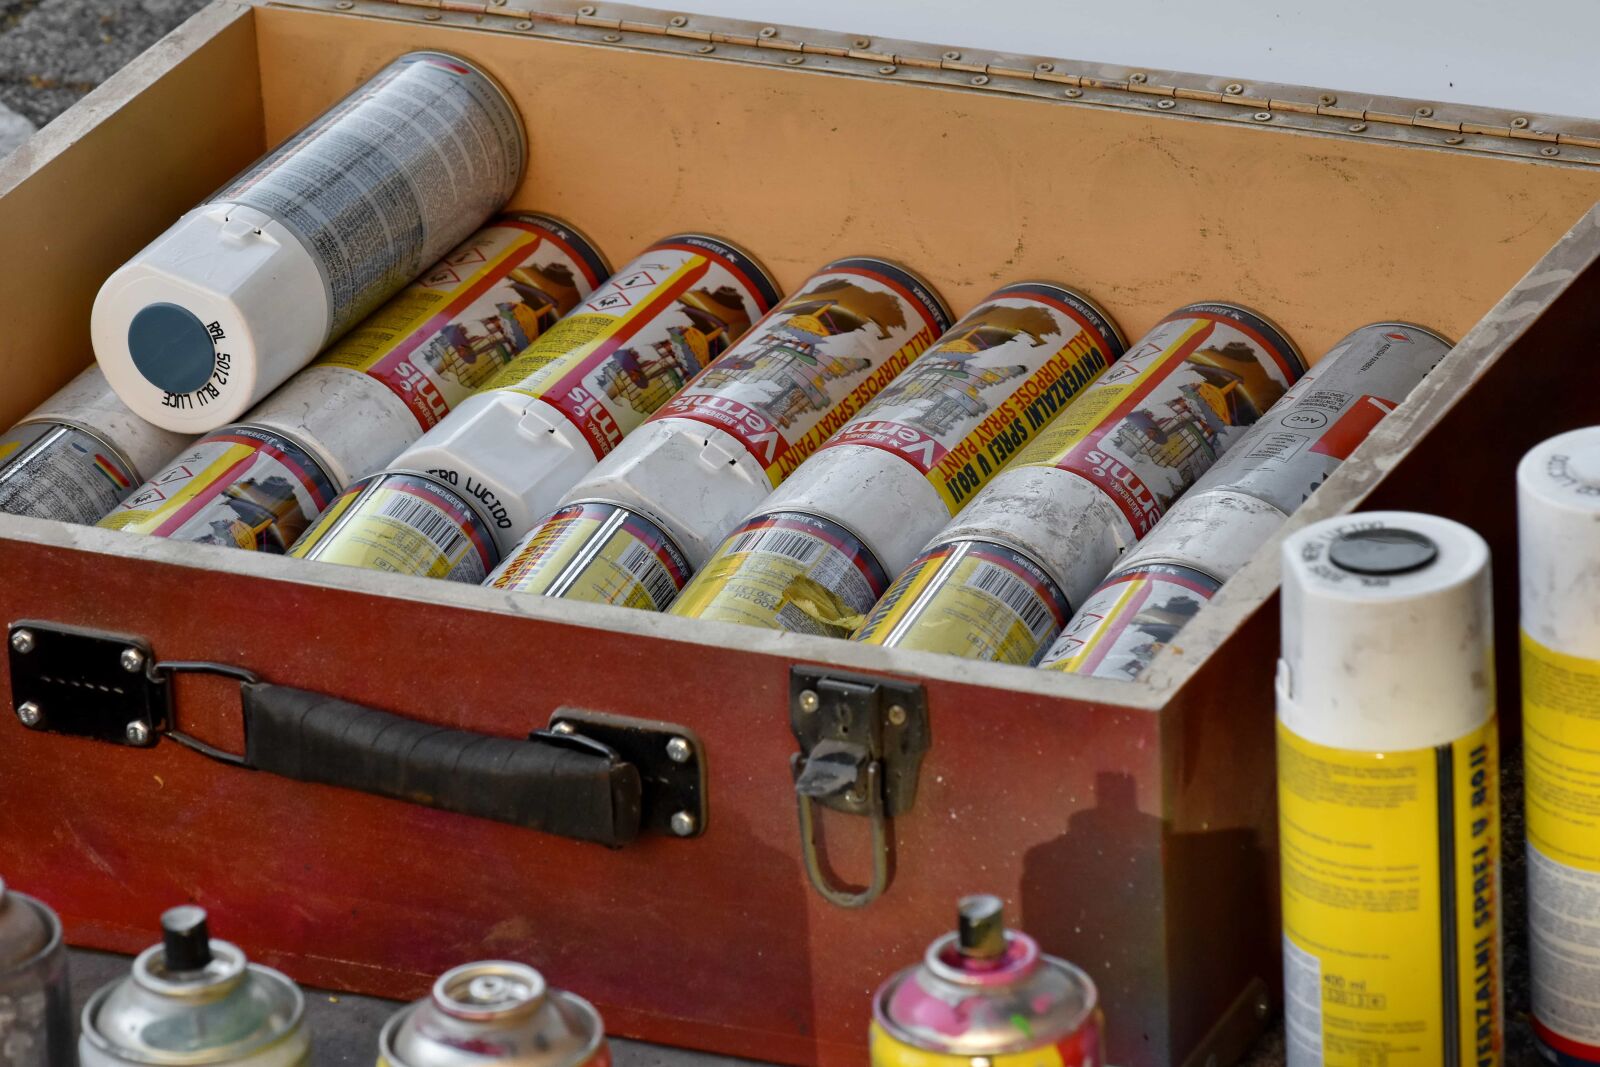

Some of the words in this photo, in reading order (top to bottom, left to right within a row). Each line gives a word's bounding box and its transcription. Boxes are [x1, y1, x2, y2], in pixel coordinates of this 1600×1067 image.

[206, 321, 226, 344] RAL
[906, 326, 937, 358] ALL
[1062, 329, 1092, 359] ALL
[213, 353, 231, 385] 5012
[394, 361, 446, 421] mis
[850, 348, 909, 408] PURPOSE
[1009, 351, 1070, 410] PURPOSE
[1023, 346, 1106, 432] UNIVERZALNI
[162, 391, 194, 410] LUCE
[196, 382, 220, 406] BLU
[668, 396, 780, 464] Vermis
[815, 397, 857, 442] SPRAY
[973, 401, 1018, 447] SPRAY
[986, 417, 1029, 466] SPREJ
[1290, 415, 1320, 424] ACC
[778, 431, 817, 479] PAINT
[936, 436, 979, 482] PAINT
[976, 453, 993, 477] U
[424, 482, 465, 510] JUGOHEMIKA
[425, 469, 459, 487] RO
[465, 477, 513, 529] LUCIDO
[944, 462, 981, 504] BOJI
